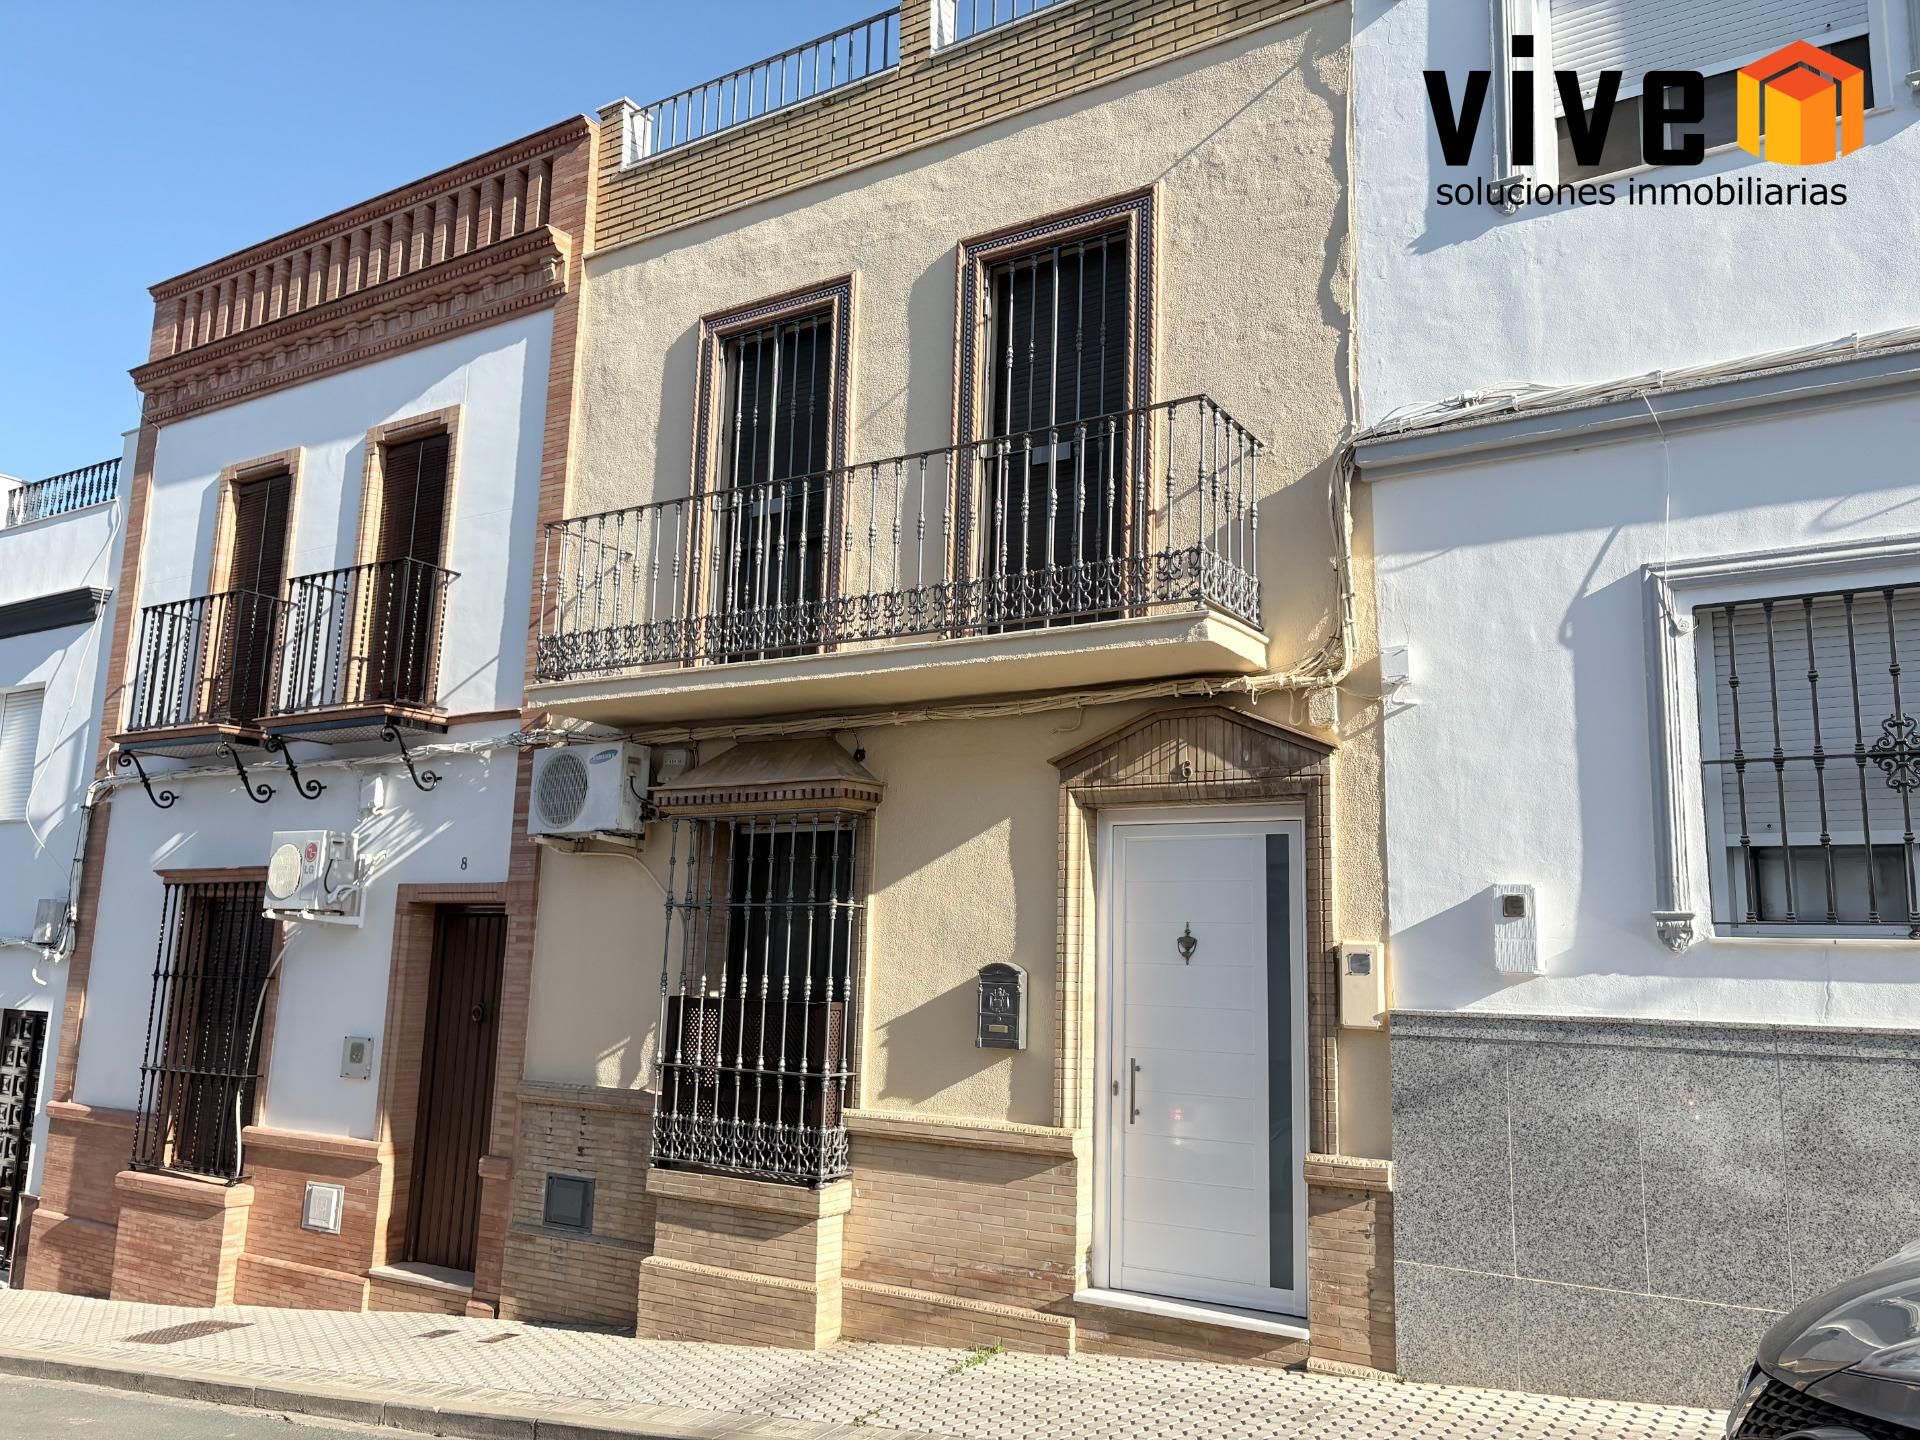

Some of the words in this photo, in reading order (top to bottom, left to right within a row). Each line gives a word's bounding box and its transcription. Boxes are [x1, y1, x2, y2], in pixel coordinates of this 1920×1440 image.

[1182, 760, 1193, 778] 6
[304, 865, 315, 875] LG
[460, 856, 468, 871] 8
